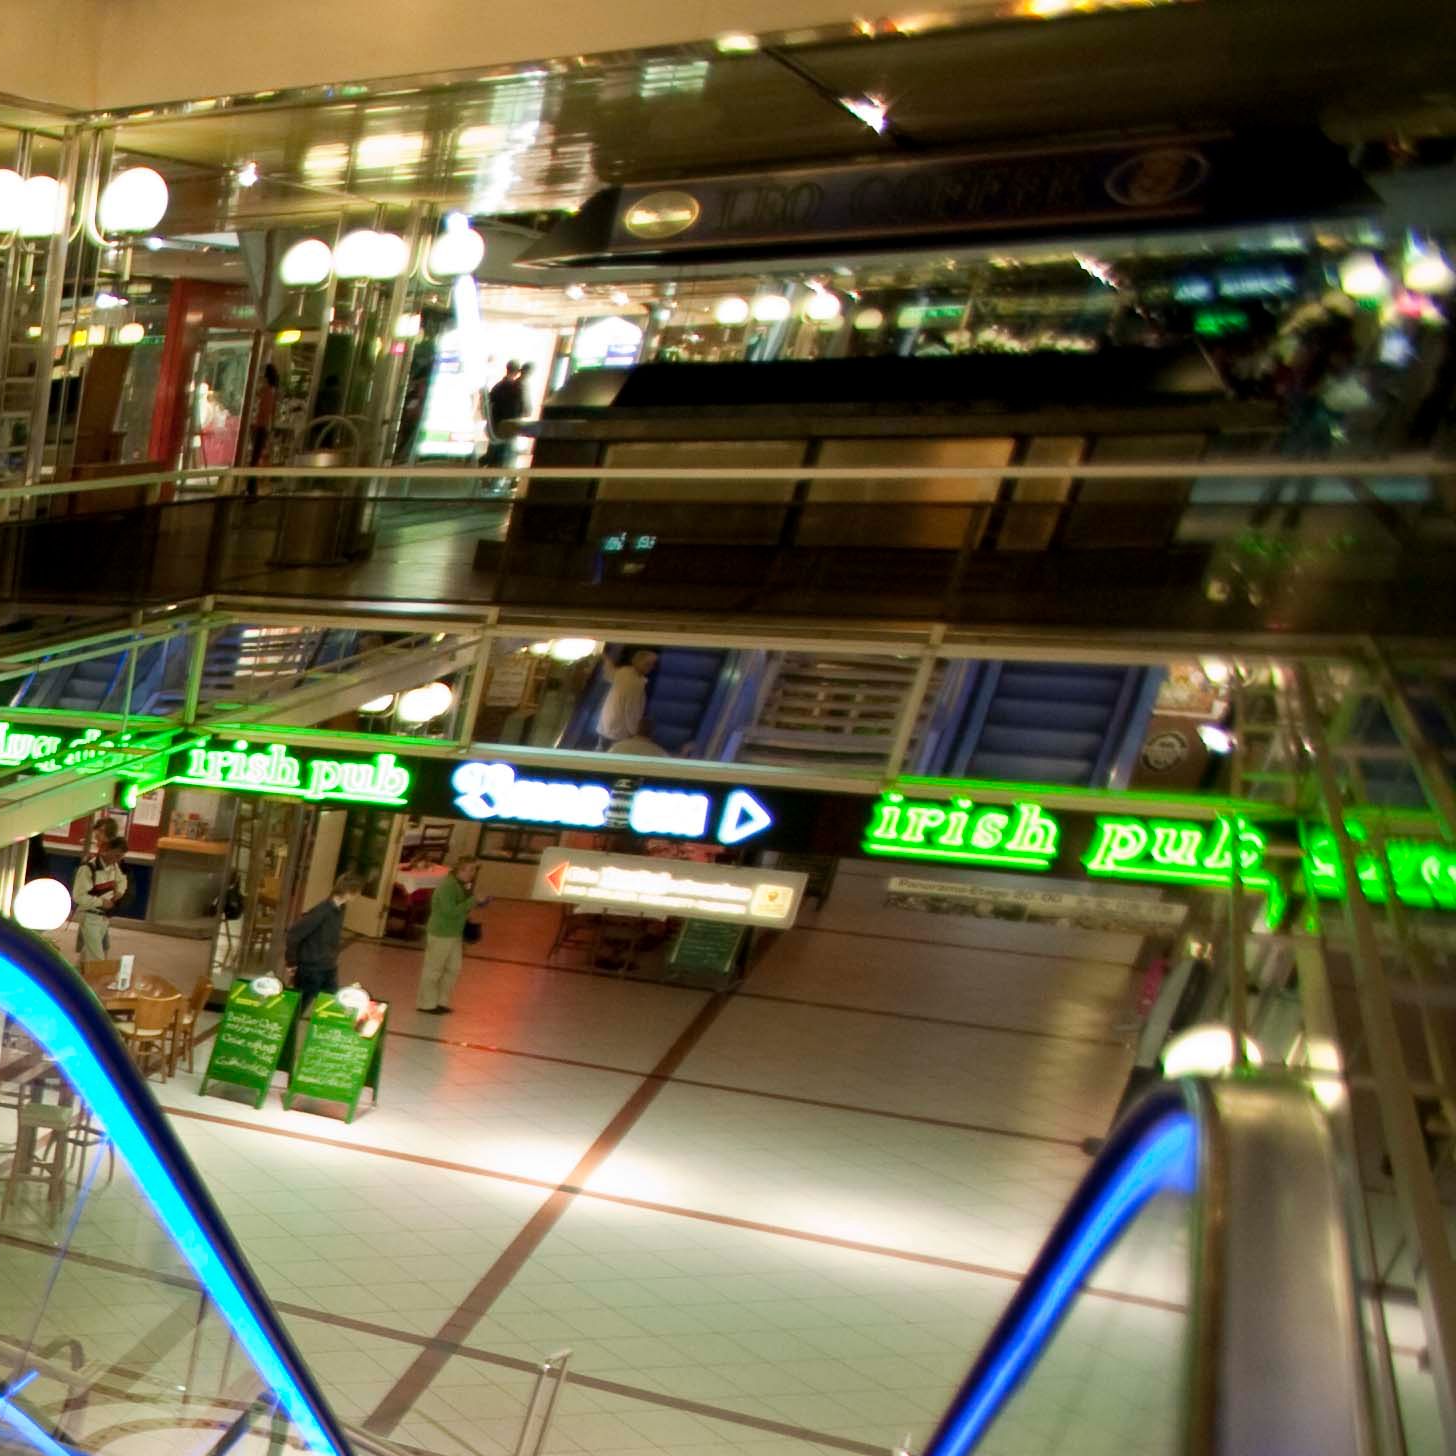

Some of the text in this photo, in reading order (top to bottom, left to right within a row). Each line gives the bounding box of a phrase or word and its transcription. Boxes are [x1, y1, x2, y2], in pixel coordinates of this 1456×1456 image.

[187, 738, 300, 788] irish
[304, 752, 411, 800] pub
[871, 792, 1057, 857] irish
